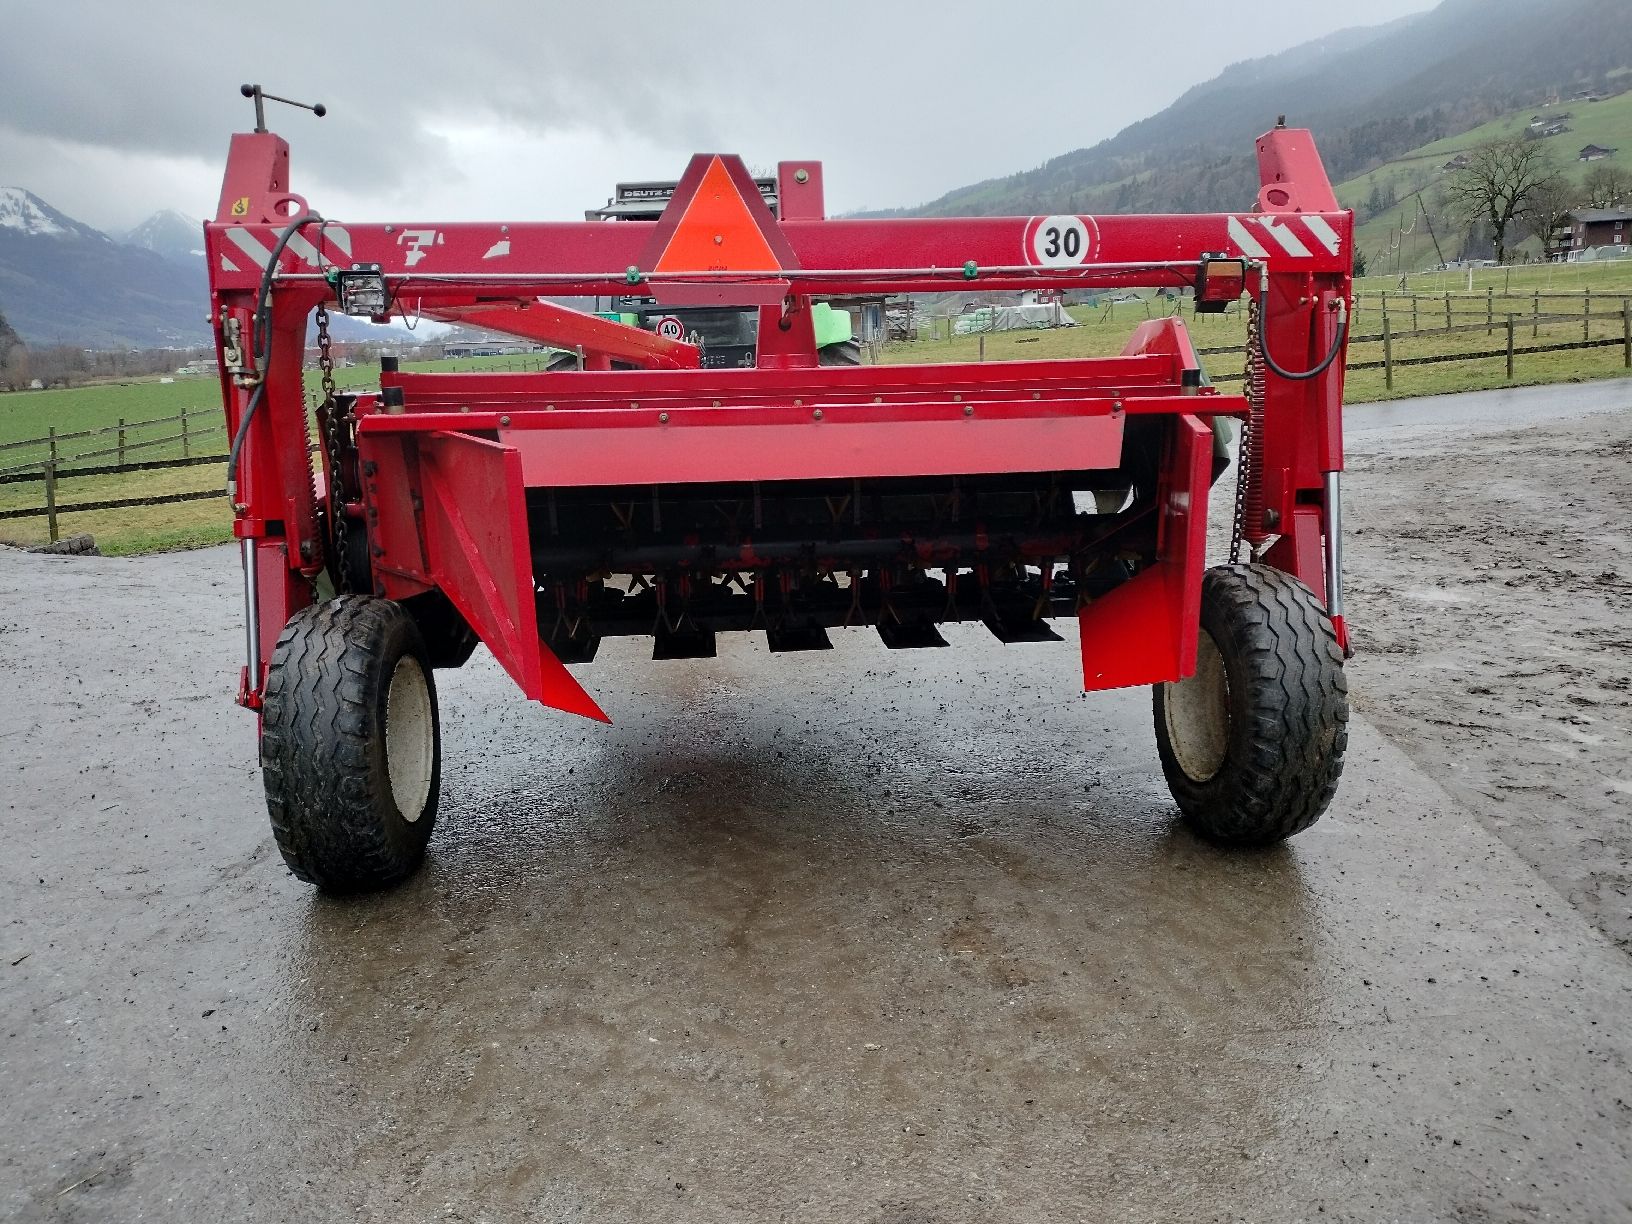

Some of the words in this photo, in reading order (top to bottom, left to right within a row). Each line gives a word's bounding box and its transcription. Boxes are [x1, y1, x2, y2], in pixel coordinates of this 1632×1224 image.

[624, 189, 676, 197] DEUTZ-F
[1044, 226, 1081, 258] 30
[664, 324, 678, 335] 40
